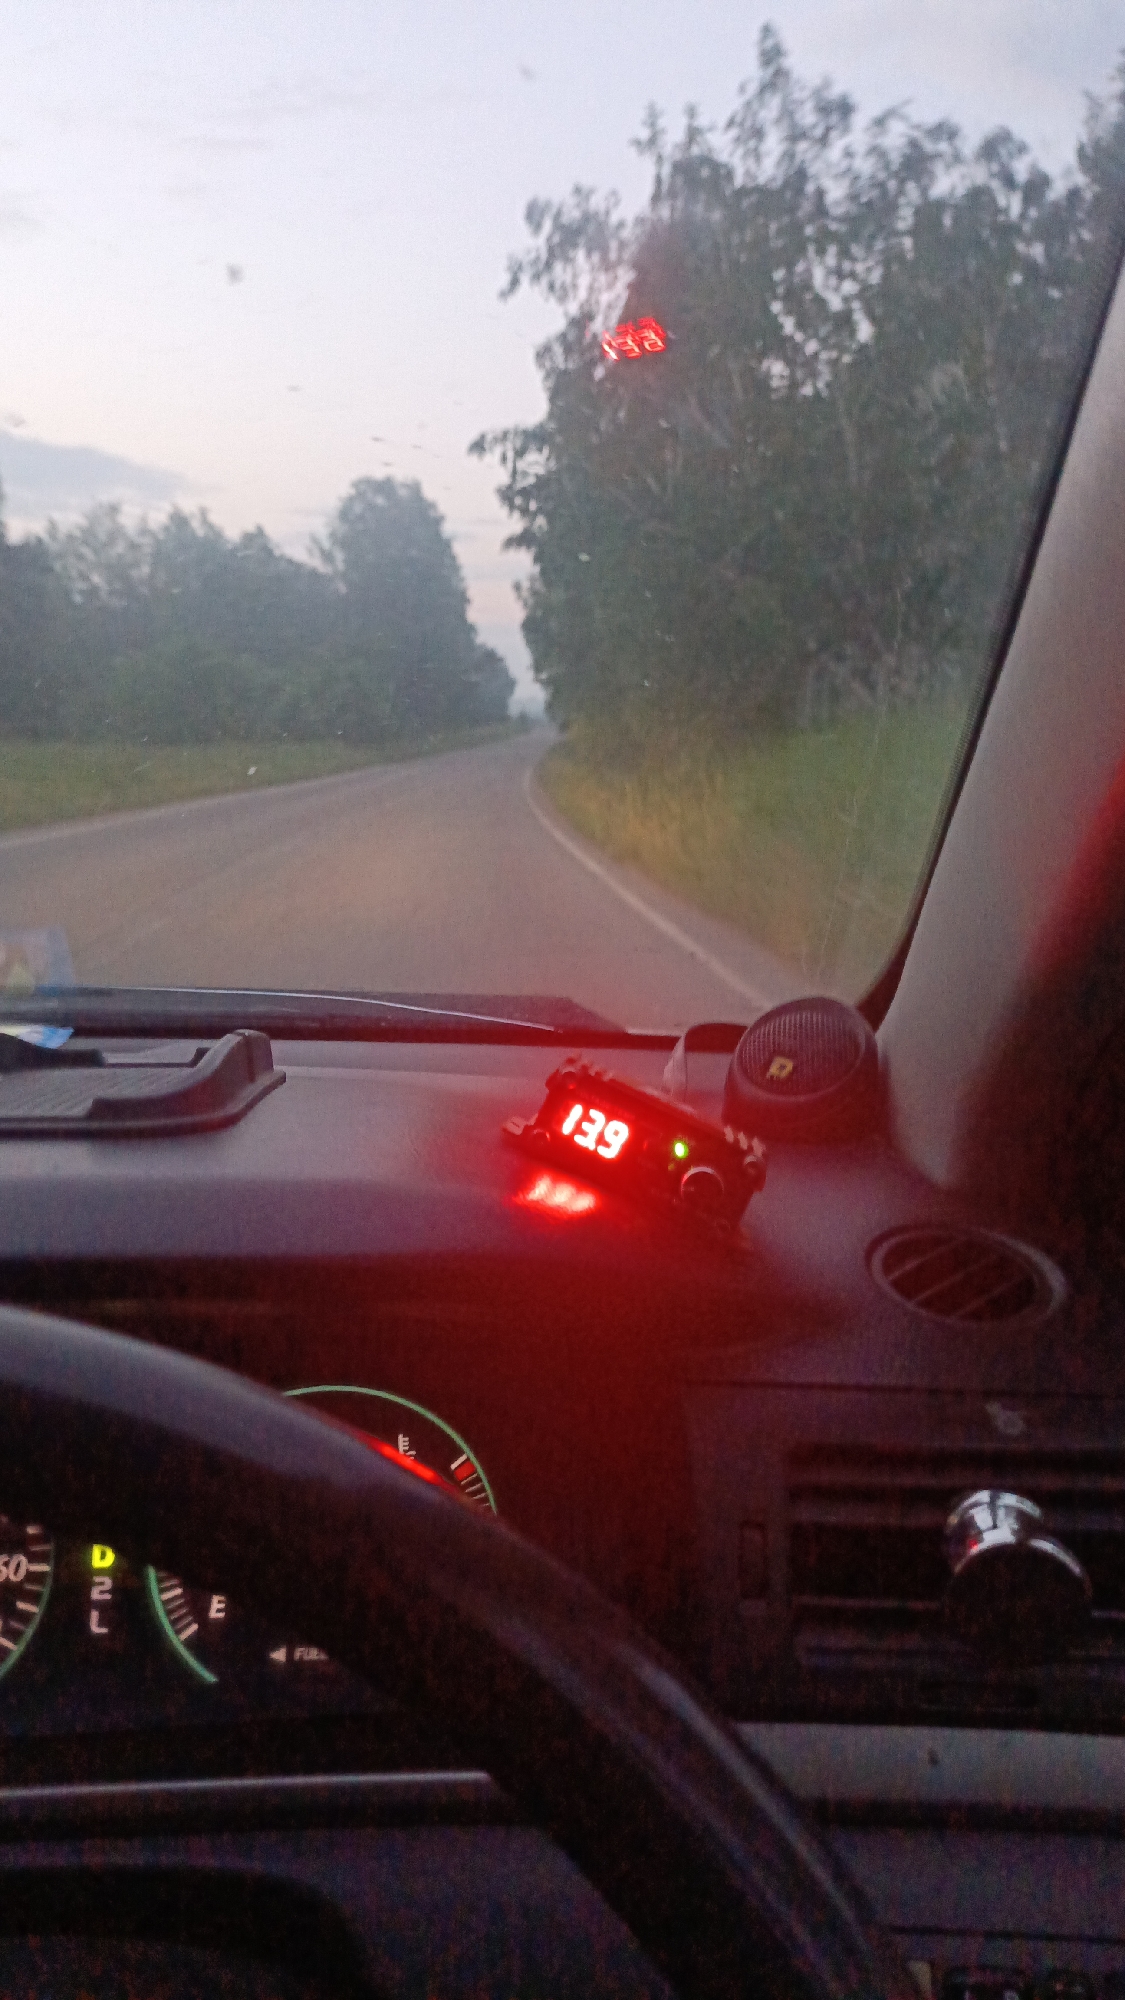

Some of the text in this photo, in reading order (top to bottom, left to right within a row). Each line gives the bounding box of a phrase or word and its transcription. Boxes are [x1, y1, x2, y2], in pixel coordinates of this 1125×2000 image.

[91, 1543, 116, 1569] D
[90, 1575, 113, 1601] 2
[207, 1593, 228, 1620] E
[89, 1608, 109, 1635] L
